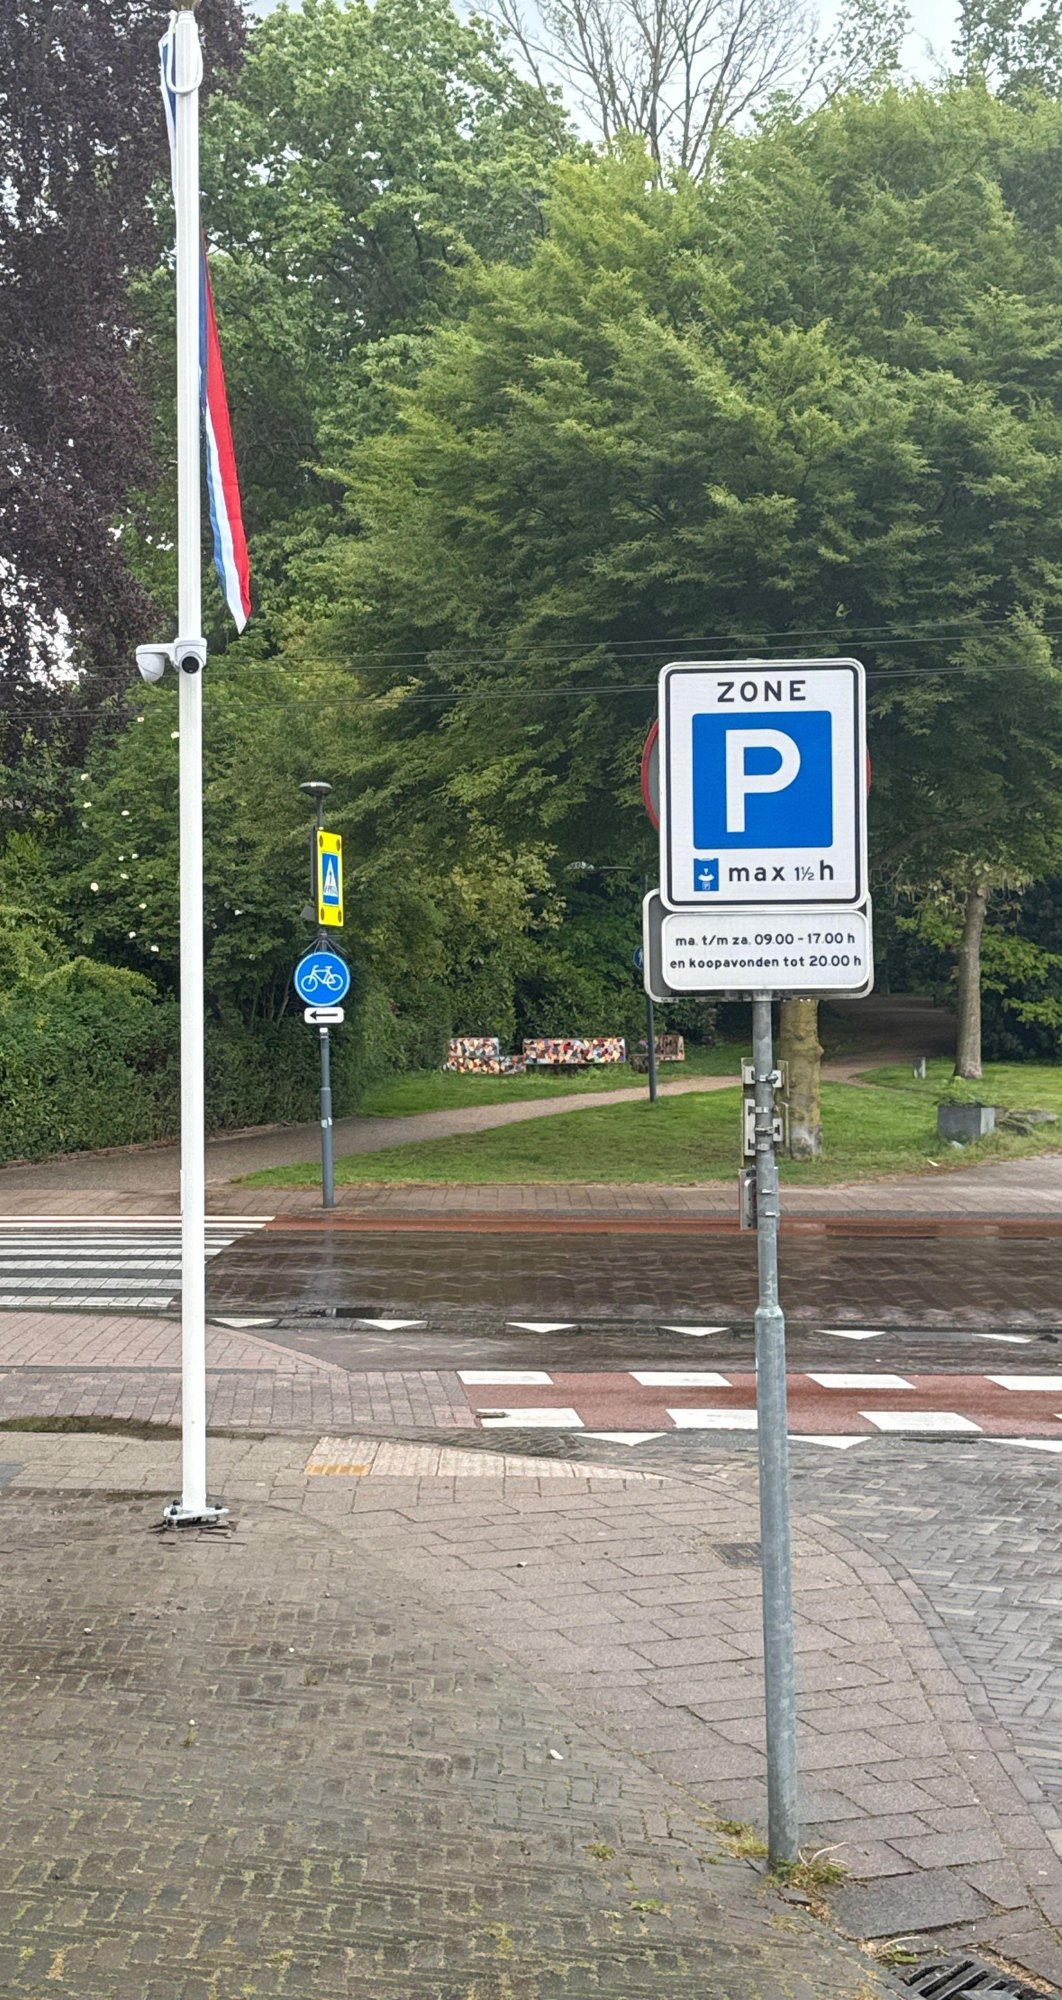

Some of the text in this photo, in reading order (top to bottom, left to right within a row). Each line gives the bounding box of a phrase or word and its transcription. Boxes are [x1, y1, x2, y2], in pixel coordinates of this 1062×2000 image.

[716, 679, 806, 703] ZONE
[725, 728, 801, 833] P
[728, 866, 786, 882] max
[701, 934, 729, 946] t/m
[754, 933, 795, 946] 09.00
[808, 932, 844, 945] 17.00
[847, 932, 857, 944] h
[669, 954, 862, 970] en koopavonden tot 20.00 h
